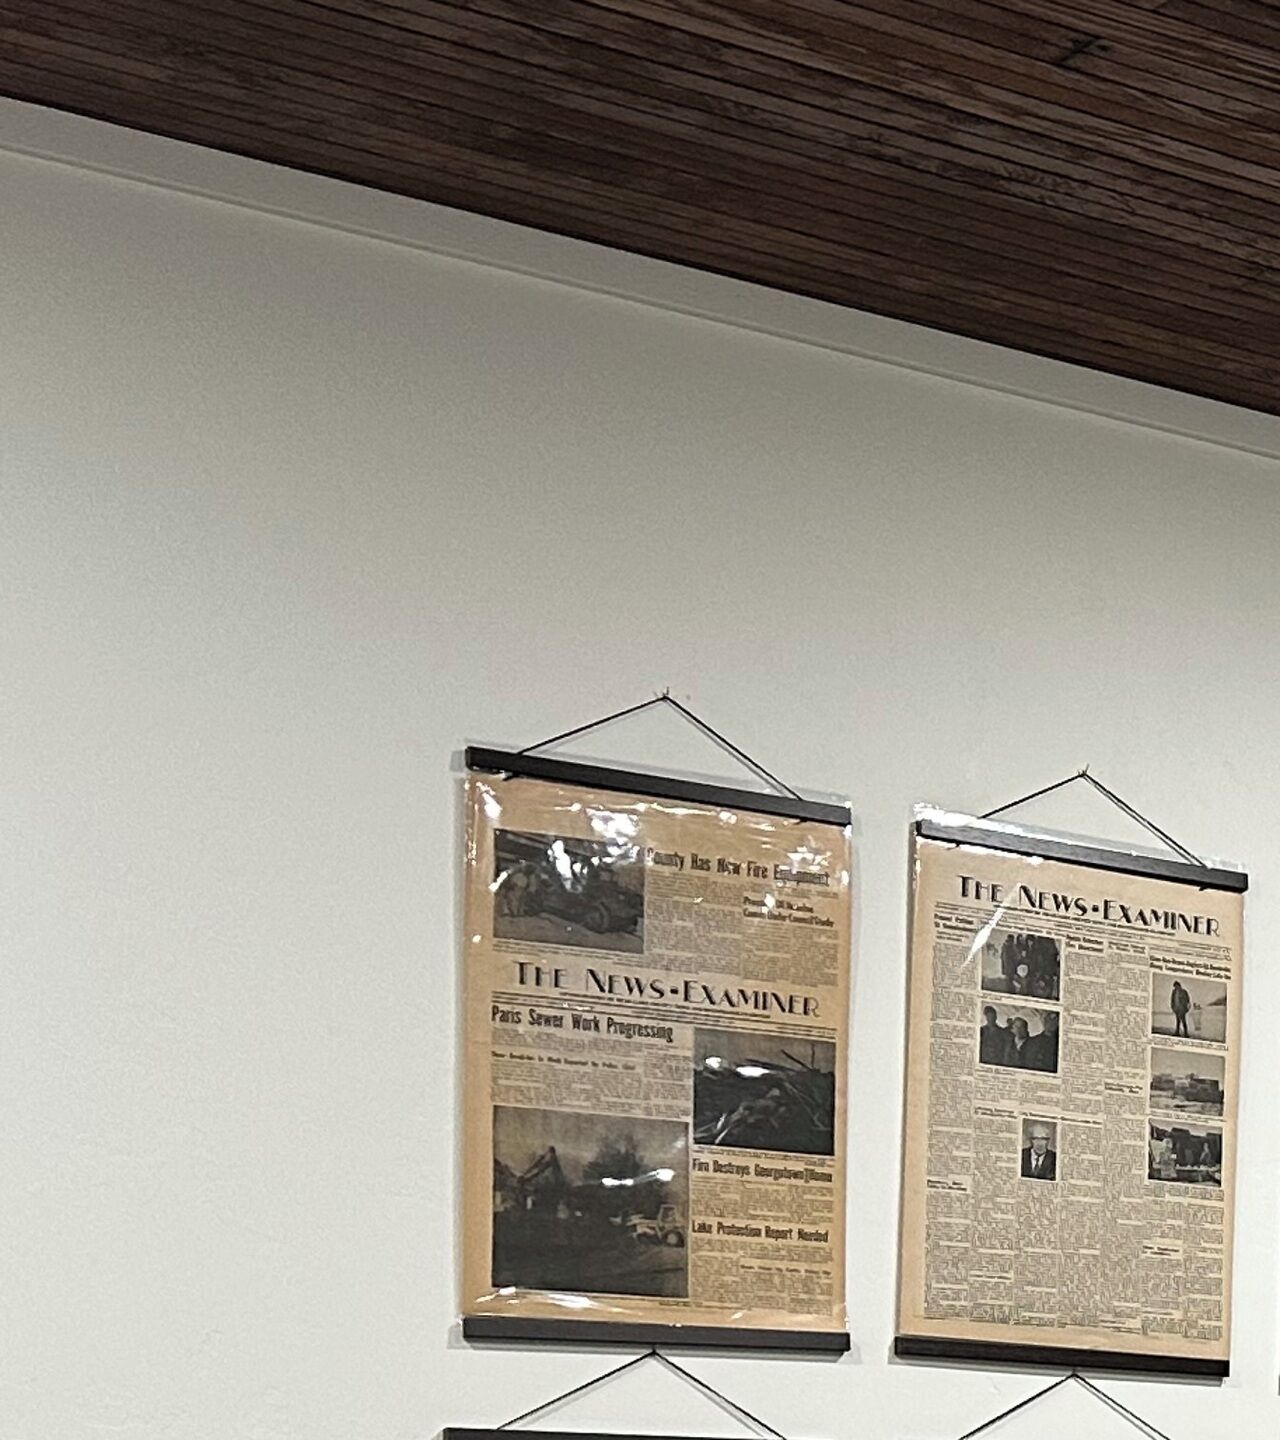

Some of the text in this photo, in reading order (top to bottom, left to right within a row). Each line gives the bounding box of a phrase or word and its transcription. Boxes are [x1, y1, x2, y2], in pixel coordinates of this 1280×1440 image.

[957, 875, 1002, 902] THE
[514, 960, 571, 989] THE
[492, 1004, 522, 1024] Paris
[528, 1007, 564, 1029] Sewer
[571, 1013, 600, 1032] Work
[606, 1017, 674, 1043] Progressing
